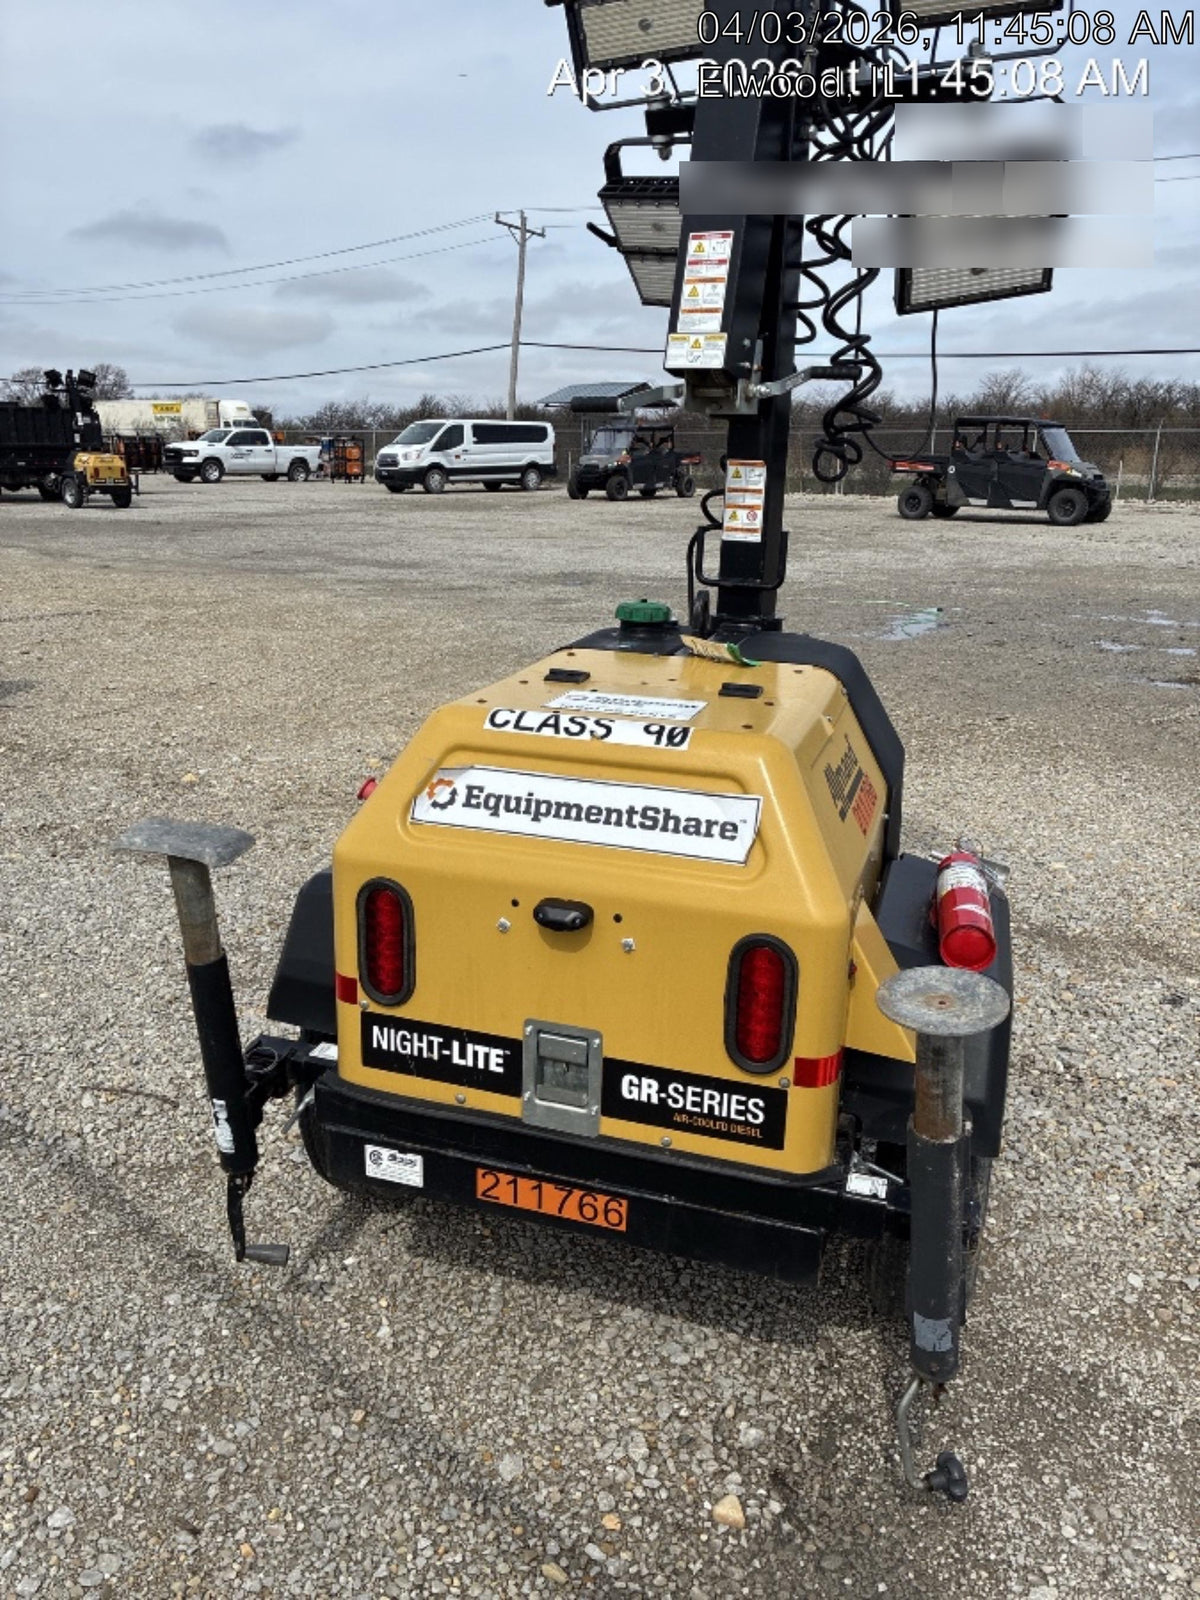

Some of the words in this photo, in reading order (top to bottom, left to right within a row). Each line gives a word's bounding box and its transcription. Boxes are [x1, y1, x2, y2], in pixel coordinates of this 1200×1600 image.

[488, 708, 615, 740] CLASS
[642, 723, 691, 747] 90
[461, 784, 740, 842] EquipmentShare
[371, 1024, 505, 1074] NIGHT-LITE
[620, 1073, 766, 1125] GR-SERIES
[479, 1169, 626, 1228] 211766
